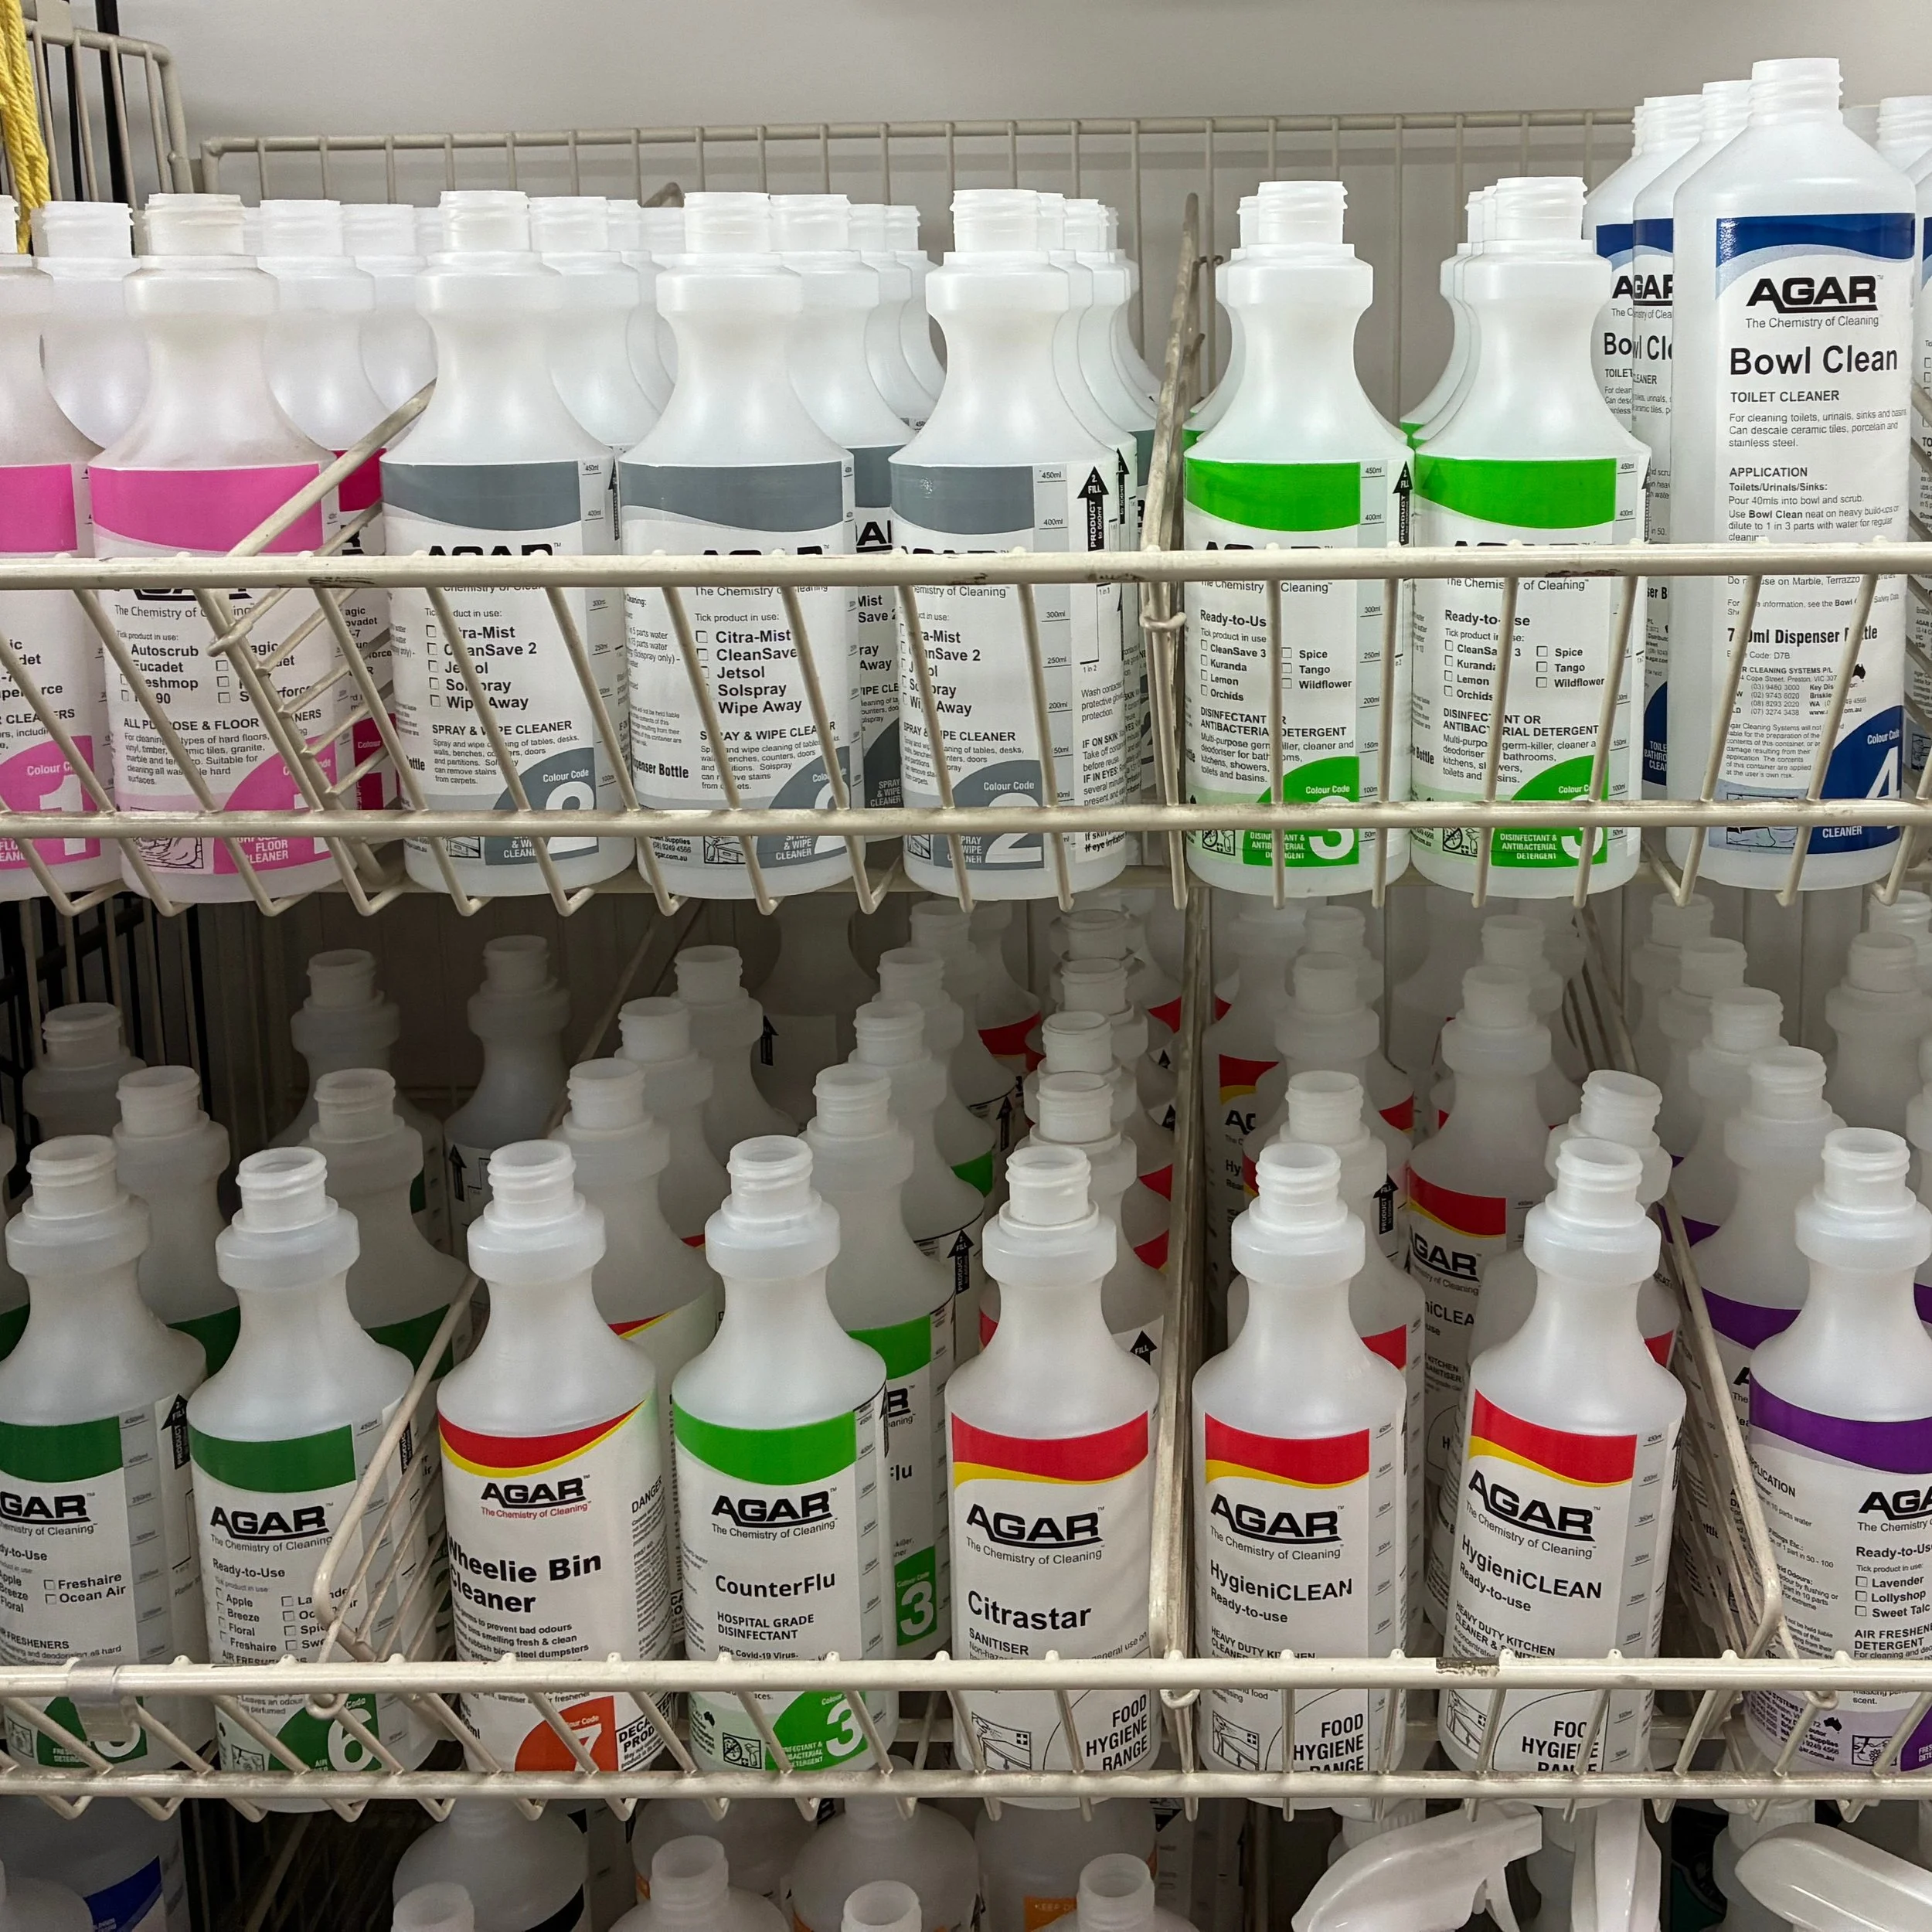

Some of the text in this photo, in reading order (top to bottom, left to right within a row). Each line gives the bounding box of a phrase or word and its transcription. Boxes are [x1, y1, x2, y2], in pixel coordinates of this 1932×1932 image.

[1746, 274, 1879, 313] AGAR
[1612, 308, 1625, 317] The
[1746, 315, 1879, 329] The Chemistry of Cleaning
[1730, 345, 1897, 375] Bowl Clean
[1730, 390, 1839, 403] TOILET CLEANER
[1730, 410, 1876, 424] For cleaning toilets, urinals, sinks
[1730, 423, 1885, 434] Can descale ceramic tiles, porcelain
[1730, 438, 1798, 447] stainless steel.
[1041, 471, 1061, 479] 450ml
[1730, 468, 1808, 477] APPLICATION
[1088, 485, 1102, 495] FILL
[1730, 482, 1828, 492] Toilets/Urinals/Sinks:
[1730, 495, 1864, 505] Pour 40mls into bowl and scrub.
[1730, 509, 1746, 518] Use
[1749, 509, 1772, 518] Bowl
[1776, 509, 1802, 518] Clean
[1838, 508, 1862, 518] heavy
[1043, 518, 1063, 526] 400ml
[1729, 521, 1751, 530] dilute
[1794, 521, 1814, 531] parts
[1818, 520, 1833, 529] with
[1836, 519, 1857, 529] water
[1859, 519, 1869, 527] for
[115, 605, 196, 620] The Chemistry of
[695, 614, 711, 622] Tick
[713, 614, 747, 624] product
[1199, 610, 1267, 628] Ready-to-Us
[716, 628, 791, 645] Citra-Mist
[1775, 628, 1841, 646] Dispenser
[131, 645, 199, 658] Autoscrub
[716, 648, 798, 662] CleanSave
[1210, 643, 1258, 658] CleanSave
[1298, 649, 1328, 662] Spice
[1555, 647, 1583, 658] Spice
[1750, 651, 1772, 659] Code:
[716, 666, 765, 679] Jetsol
[1210, 659, 1247, 672] Kuranda
[1299, 665, 1330, 677] Tango
[1555, 662, 1585, 675] Tango
[1210, 675, 1239, 686] Lemon
[1298, 679, 1352, 690] Wildflower
[1554, 676, 1604, 688] Wildflower
[718, 683, 787, 699] Solspray
[1210, 689, 1244, 702] Orchids
[718, 698, 802, 716] Wipe Away
[1200, 707, 1267, 724] DISINFECTANT
[214, 718, 259, 730] FLOOR
[431, 721, 573, 736] SPRAY CLEANER
[219, 732, 270, 743] hard floors,
[958, 730, 1015, 742] CLEANER
[1282, 726, 1346, 738] DETERGENT
[1201, 733, 1247, 748] Multi-purpose
[231, 743, 264, 753] granite,
[206, 755, 243, 764] Suitable
[1503, 752, 1556, 764] bathrooms,
[983, 781, 1035, 791] Colour Code
[1822, 826, 1862, 838] CLEANER
[256, 839, 288, 850] FLOOR
[1502, 842, 1557, 851] ANTIBACTERIAL
[481, 1476, 587, 1509] AGAR
[711, 1490, 834, 1529] AGAR
[1468, 1469, 1595, 1542] AGAR
[210, 1504, 330, 1540] AGAR
[966, 1503, 1104, 1549] AGAR
[1210, 1494, 1342, 1545] AGAR
[712, 1519, 836, 1541] The Chemistry of Cleaning
[447, 1531, 602, 1583] Wheelie Bin
[966, 1536, 1102, 1566] The Chemistry of Cleaning
[213, 1558, 286, 1578] Ready-to-Use
[1461, 1534, 1602, 1599] HygieniCLEAN
[58, 1573, 122, 1590] Freshaire
[715, 1570, 836, 1599] CounterFlu
[1210, 1560, 1352, 1601] HygieniCLEAN
[1460, 1561, 1532, 1612] Ready-to-use
[1872, 1574, 1923, 1589] Lavender
[59, 1585, 126, 1604] Ocean Air
[451, 1566, 536, 1614] Cleaner
[1871, 1589, 1927, 1604] Lollyshop
[226, 1594, 253, 1607] Apple
[1210, 1586, 1288, 1623] Ready-to-use
[227, 1607, 260, 1621] Breeze
[900, 1581, 934, 1637] 3
[968, 1590, 1091, 1631] Citrastar
[1872, 1603, 1930, 1618] Sweet Talc
[717, 1611, 815, 1628] HOSPITAL GRADE
[229, 1624, 255, 1636] Floral
[487, 1624, 572, 1634] prevent bad odours
[717, 1624, 798, 1641] DISINFECTANT
[1456, 1600, 1555, 1657] HEAVY DUTY KITCHEN
[230, 1638, 277, 1651] Freshaire
[515, 1634, 577, 1648] fresh clean
[969, 1627, 1029, 1656] SANITISER
[1854, 1637, 1923, 1651] DETERGENT
[538, 1645, 589, 1658] dumpsters
[736, 1649, 771, 1658] Covid-19
[1853, 1696, 1877, 1706] scent.
[1112, 1694, 1147, 1728] FOOD
[1321, 1713, 1363, 1738] FOOD
[1086, 1714, 1148, 1758] HYGIENE
[1103, 1736, 1148, 1770] RANGE
[1294, 1734, 1364, 1761] HYGIENE
